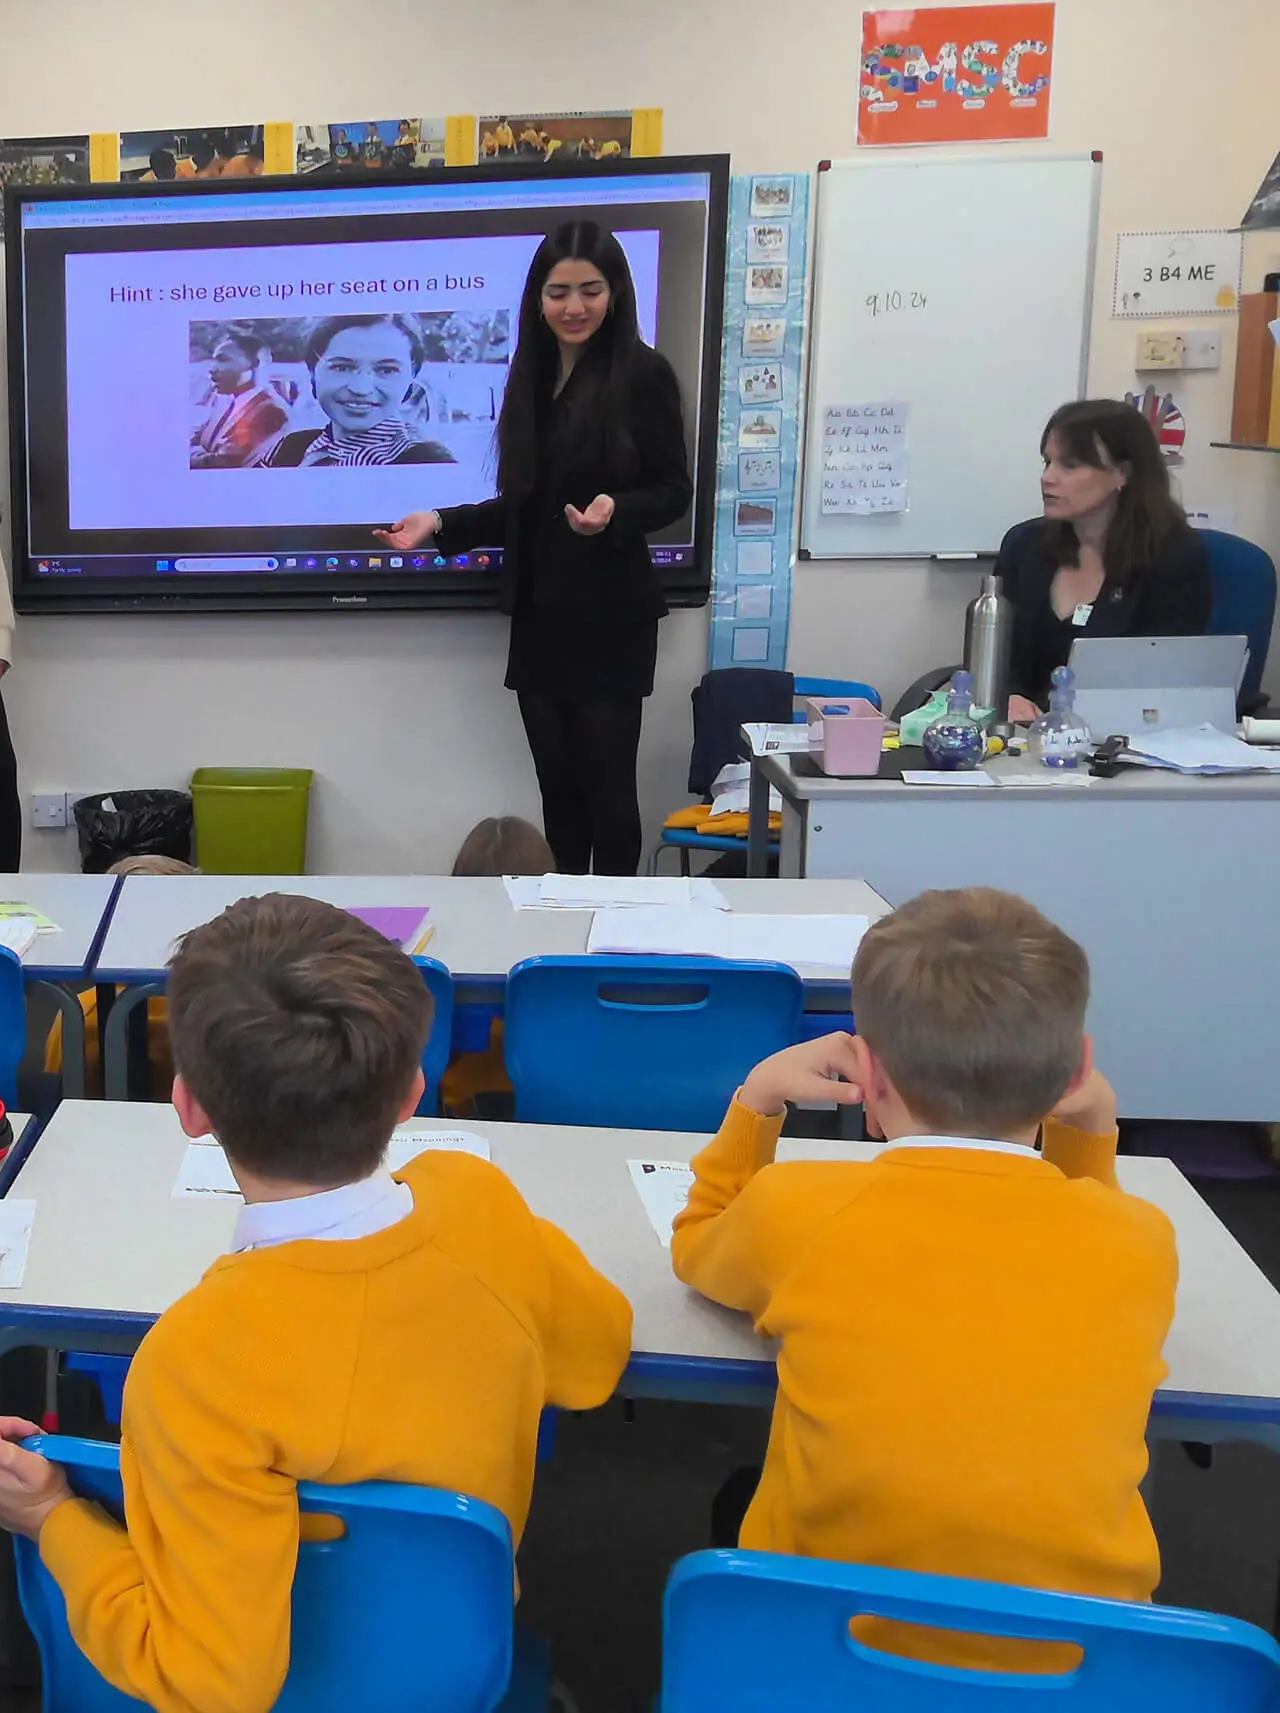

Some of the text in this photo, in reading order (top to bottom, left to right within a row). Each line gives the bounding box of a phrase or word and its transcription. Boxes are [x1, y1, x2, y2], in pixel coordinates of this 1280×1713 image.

[861, 39, 1050, 102] SMSC
[109, 286, 153, 303] Hint
[170, 284, 208, 301] she
[213, 284, 262, 303] gave
[267, 282, 294, 301] up
[300, 279, 335, 296] her
[340, 278, 387, 294] seat
[393, 278, 419, 292] on
[426, 277, 438, 291] a
[445, 273, 485, 290] bus
[1143, 264, 1216, 282] 3 B4 ME
